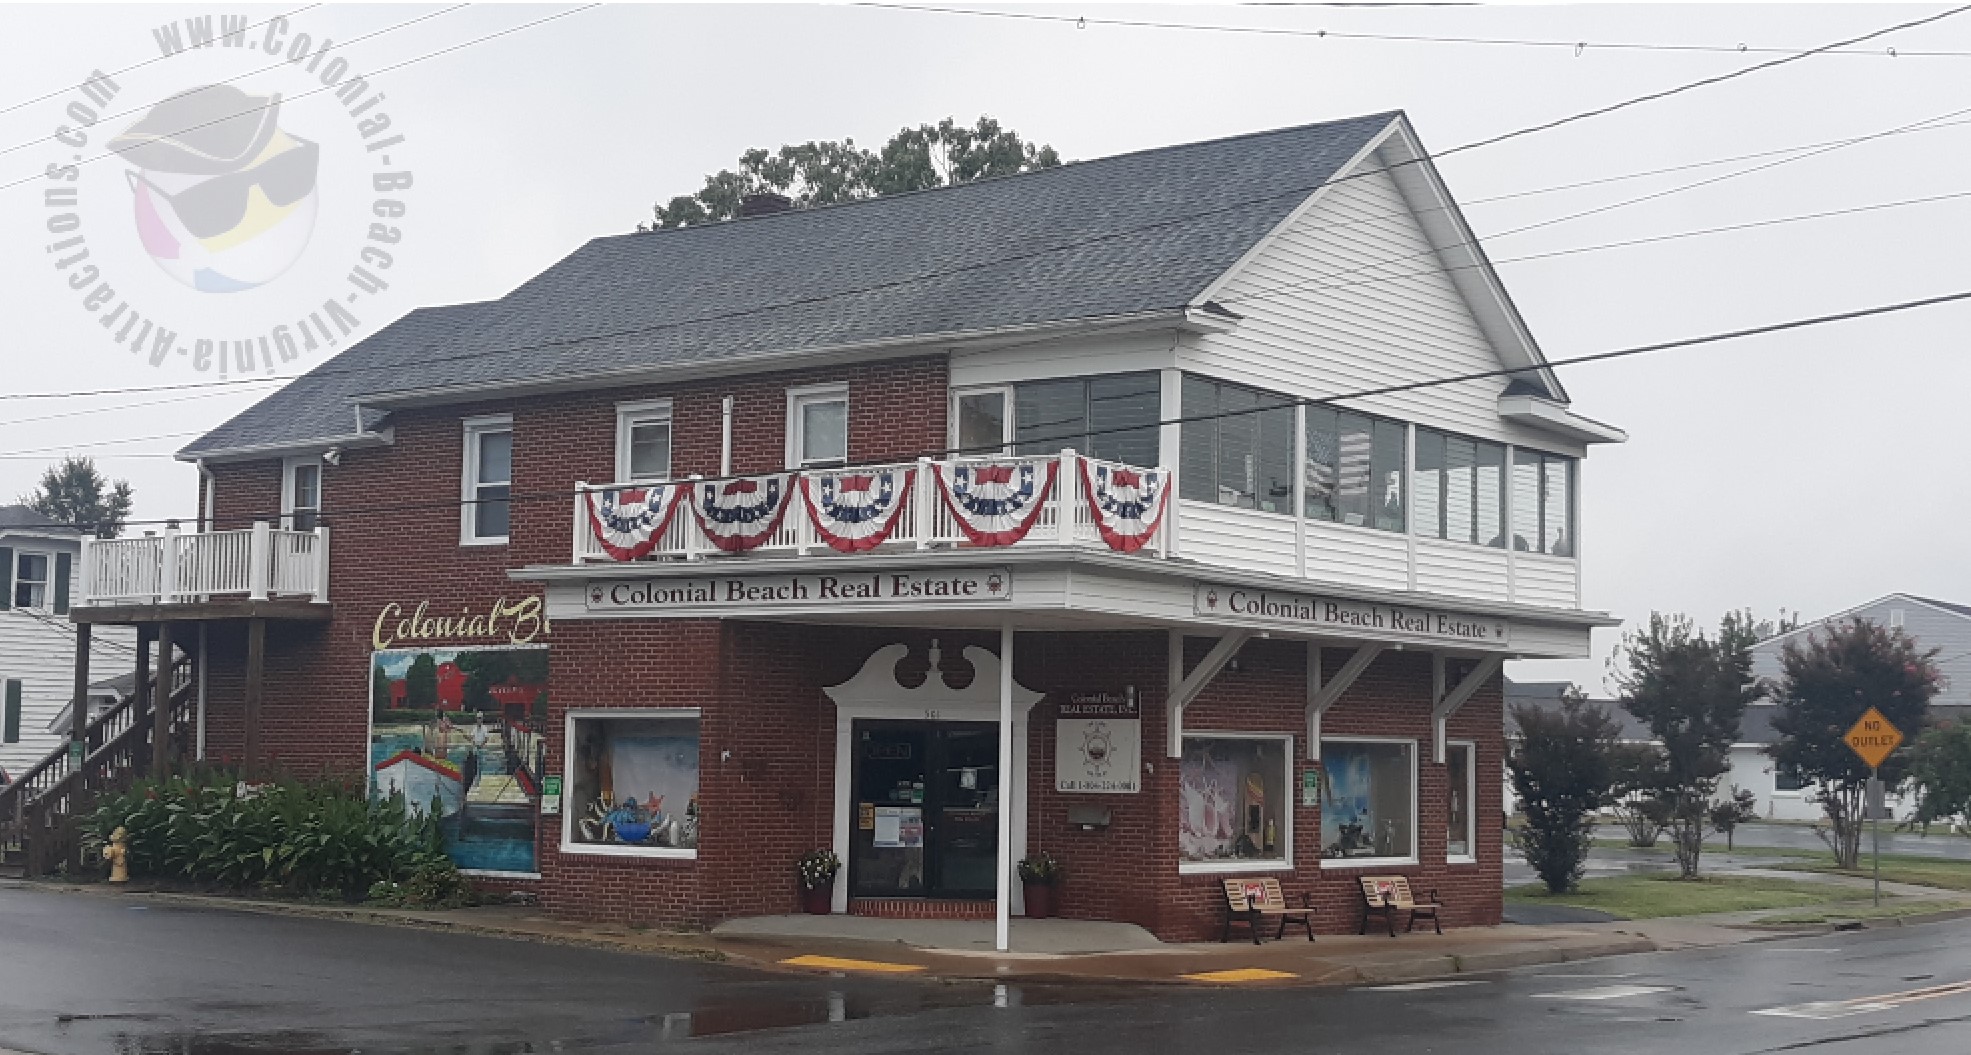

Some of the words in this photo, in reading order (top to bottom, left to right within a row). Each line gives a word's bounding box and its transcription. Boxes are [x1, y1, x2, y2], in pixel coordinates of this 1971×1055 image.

[610, 581, 716, 606] Colonial
[725, 577, 809, 601] Beach
[818, 574, 882, 599] Real
[890, 574, 978, 598] Estate
[372, 597, 506, 650] Colonial
[1229, 590, 1317, 621] Colonial
[1323, 601, 1384, 628] Beach
[1390, 607, 1431, 633] Real
[1436, 613, 1488, 639] Estate
[1060, 704, 1081, 714] REAL
[1864, 720, 1880, 732] NO
[1852, 734, 1894, 747] OUTLET
